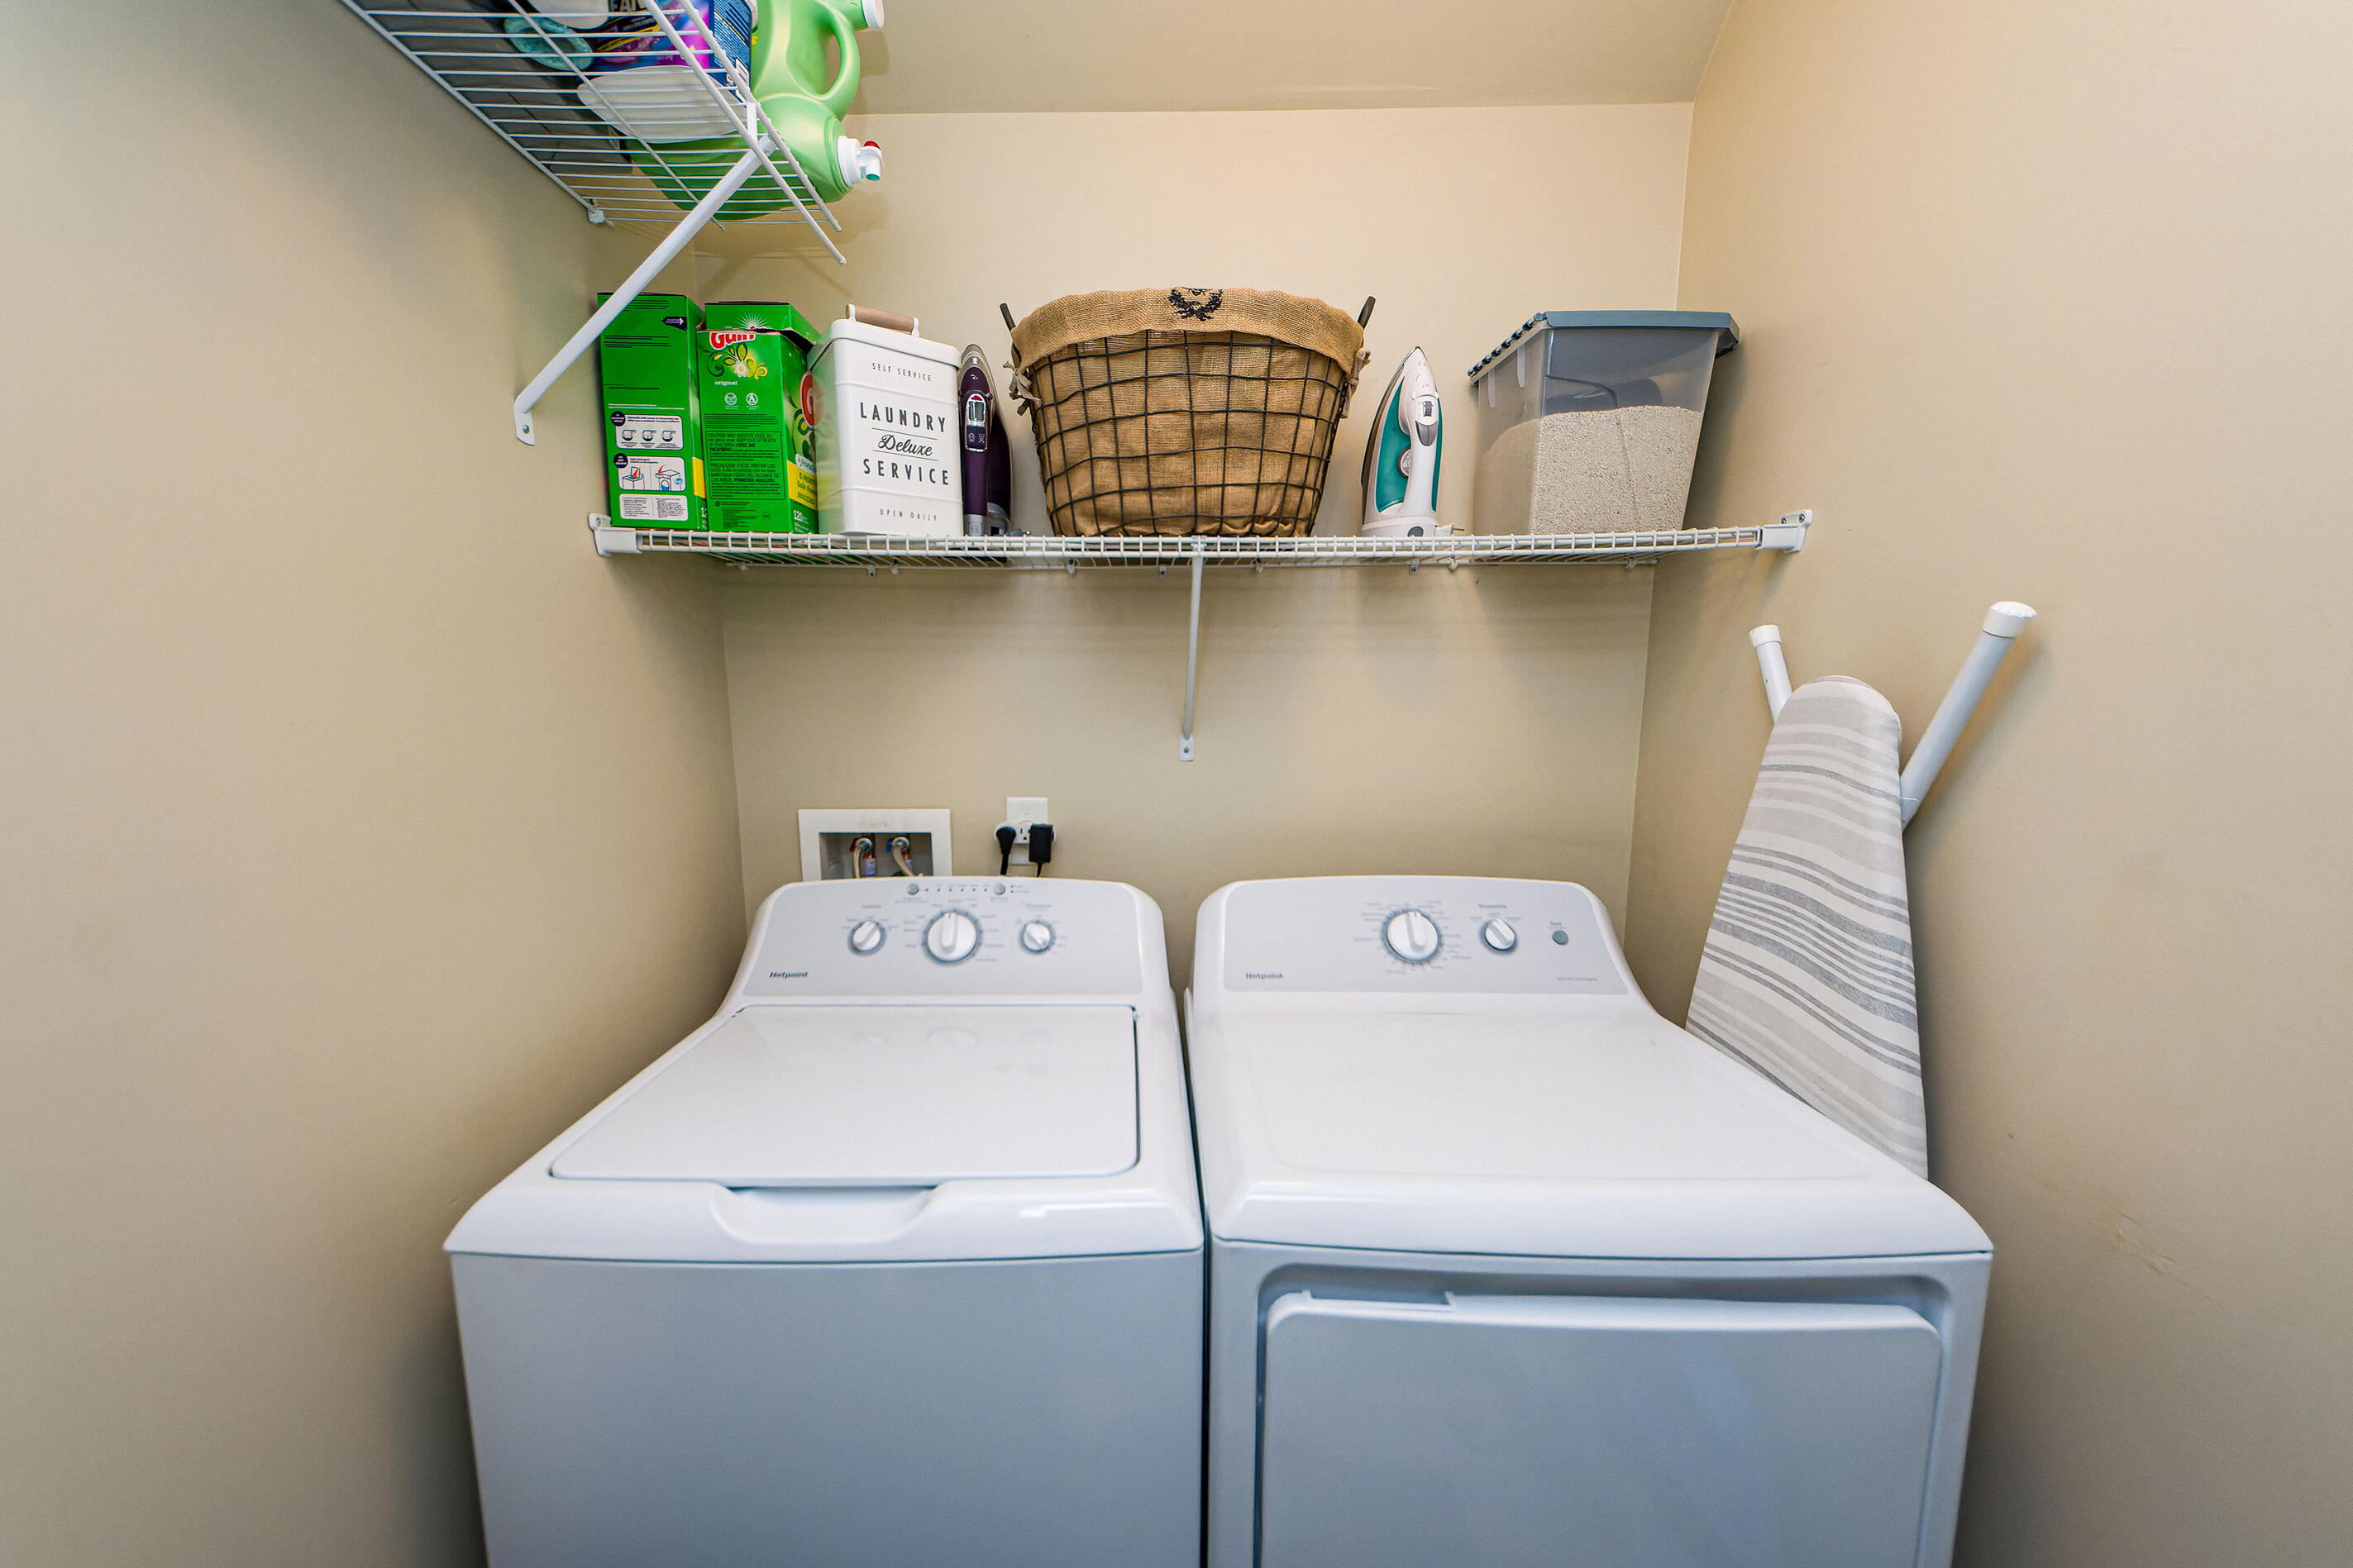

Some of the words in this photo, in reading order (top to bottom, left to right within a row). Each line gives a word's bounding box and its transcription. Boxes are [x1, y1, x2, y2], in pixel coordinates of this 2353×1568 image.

[871, 362, 892, 373] SELF
[897, 368, 932, 382] SERVICE
[860, 402, 946, 432] LAUNDRY
[877, 434, 933, 456] Deluxe
[862, 458, 949, 485] SERVICE
[879, 508, 903, 517] OPEN
[910, 512, 937, 522] DAILY
[1244, 971, 1283, 979] Hotpoint
